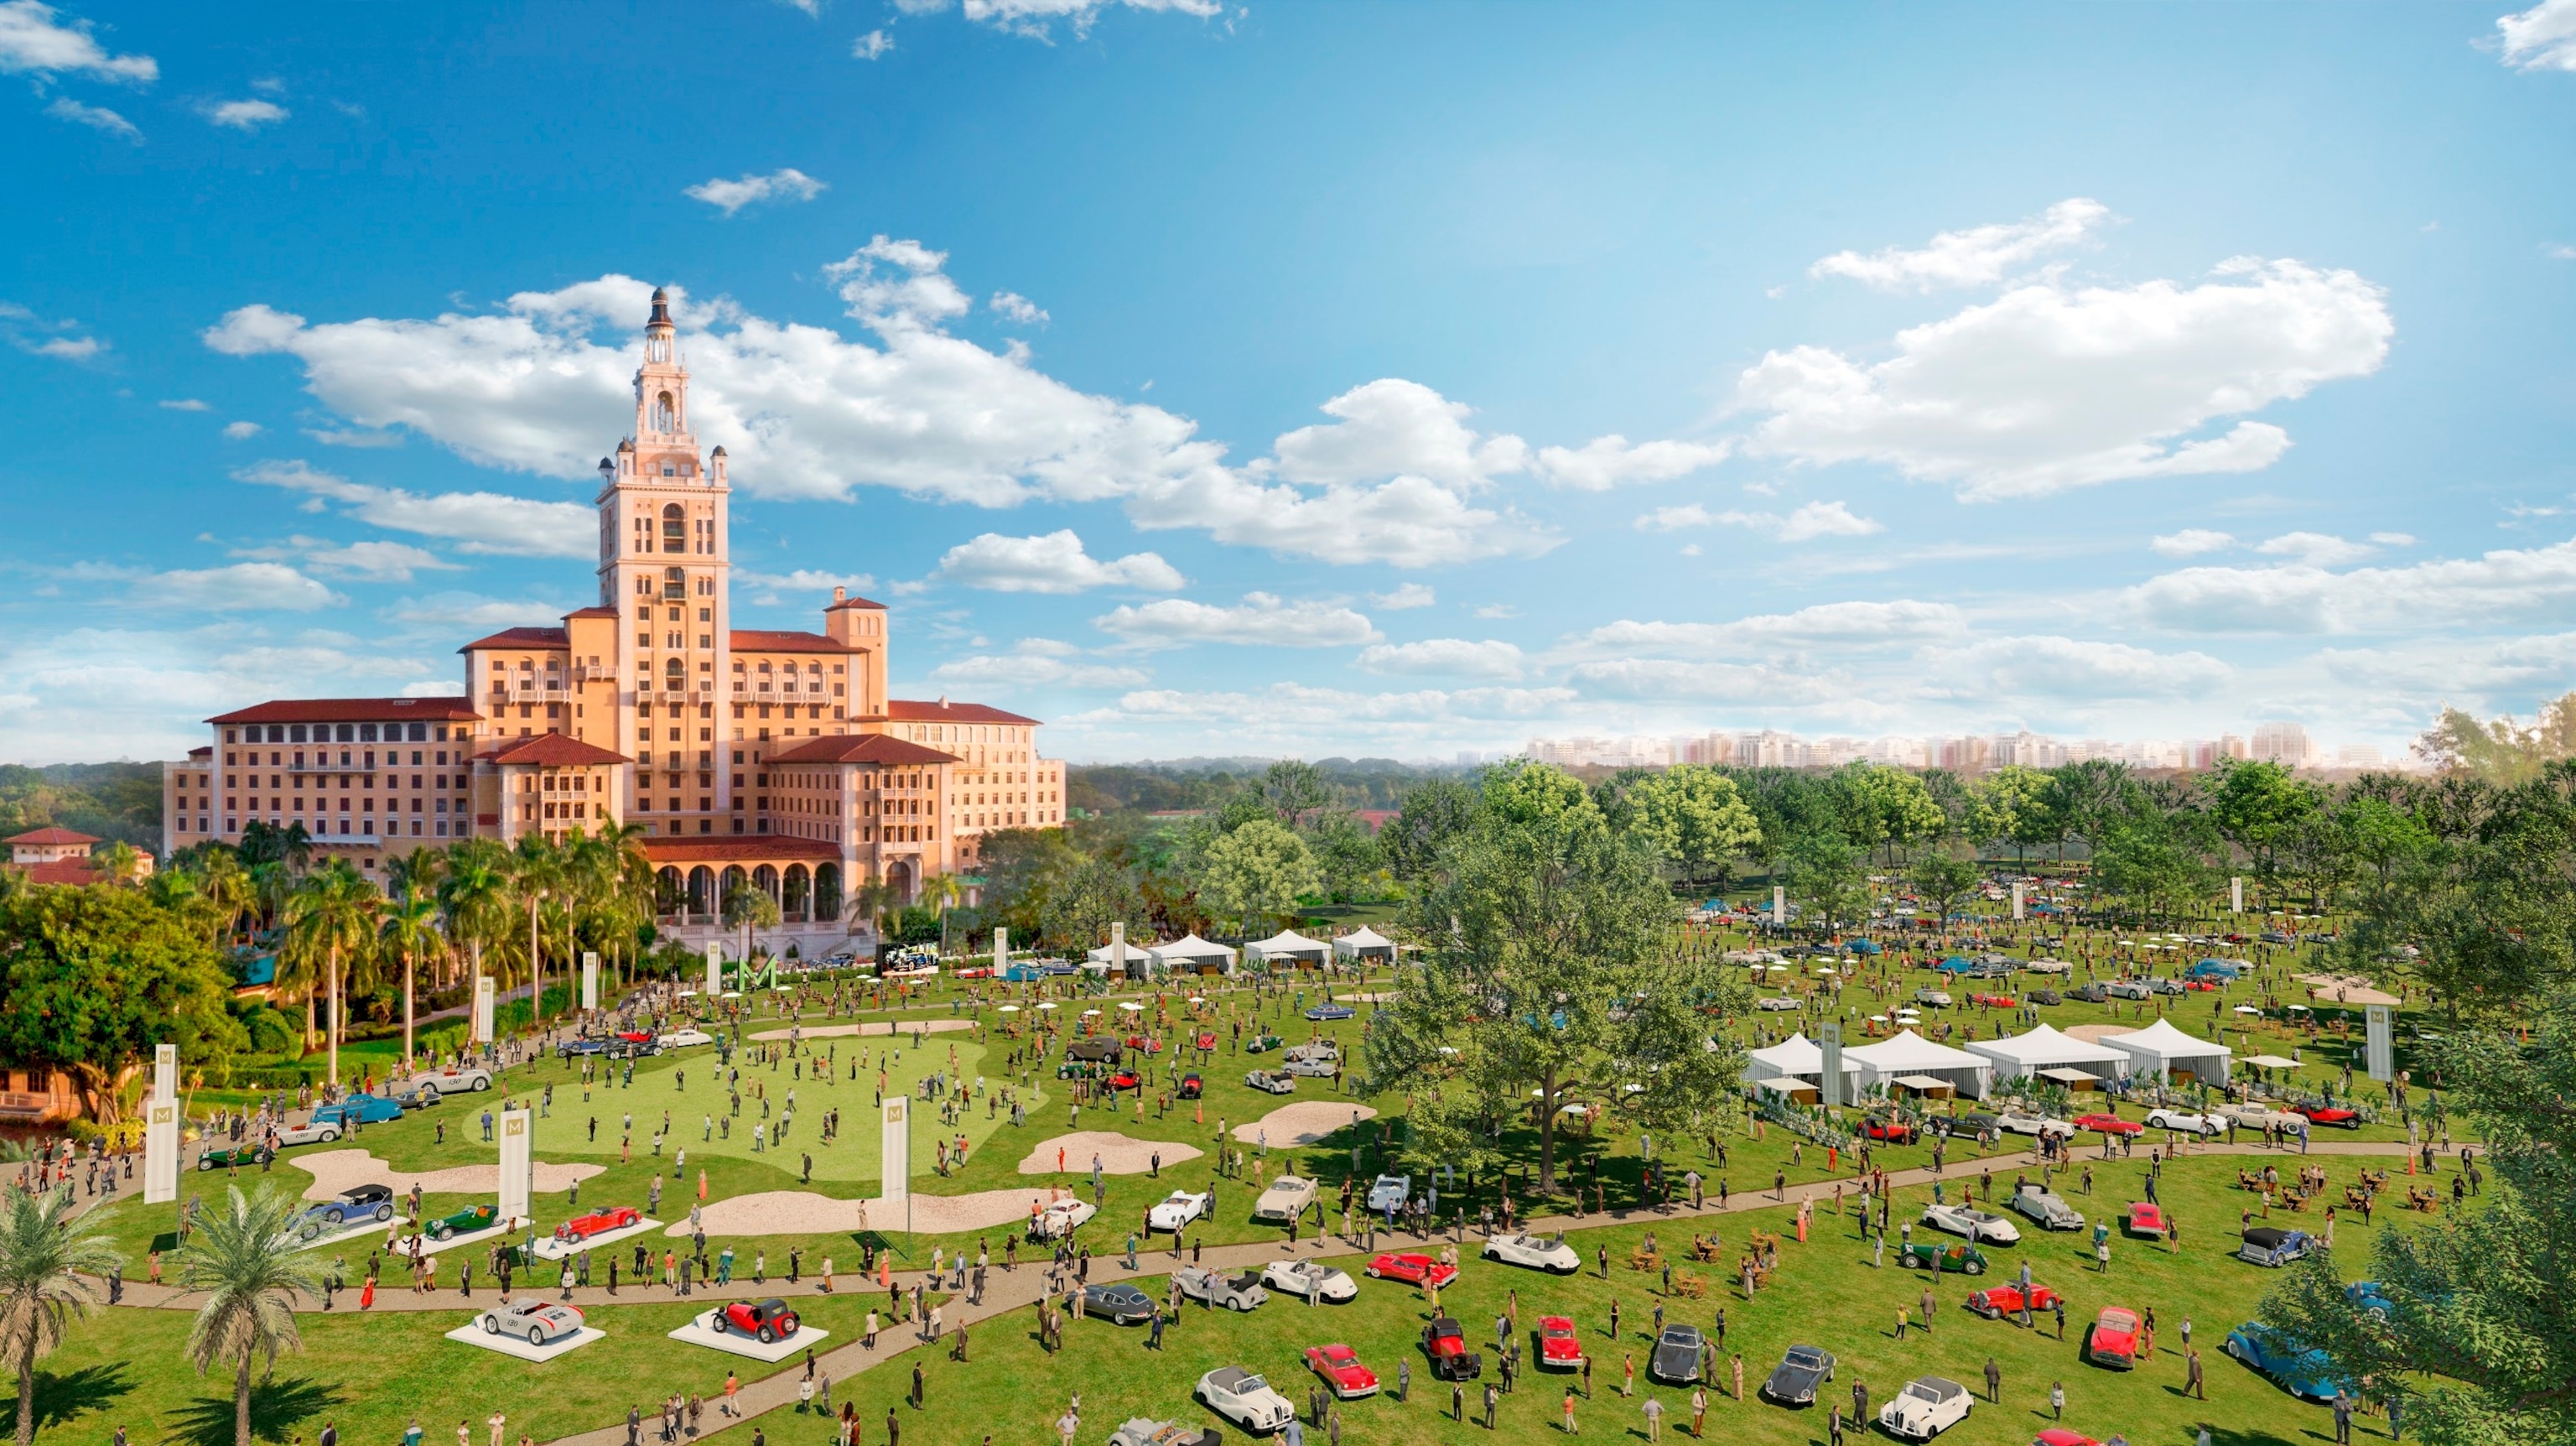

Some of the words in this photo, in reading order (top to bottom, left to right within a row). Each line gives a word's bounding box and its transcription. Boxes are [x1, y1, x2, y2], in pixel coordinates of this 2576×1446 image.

[738, 953, 777, 993] M
[2372, 1012, 2382, 1021] M
[1826, 1031, 1835, 1041] M
[161, 1053, 169, 1062] M
[157, 1110, 169, 1121] M
[890, 1109, 900, 1121] M
[509, 1120, 521, 1133] M
[544, 1308, 558, 1317] 130
[507, 1319, 519, 1328] 130
